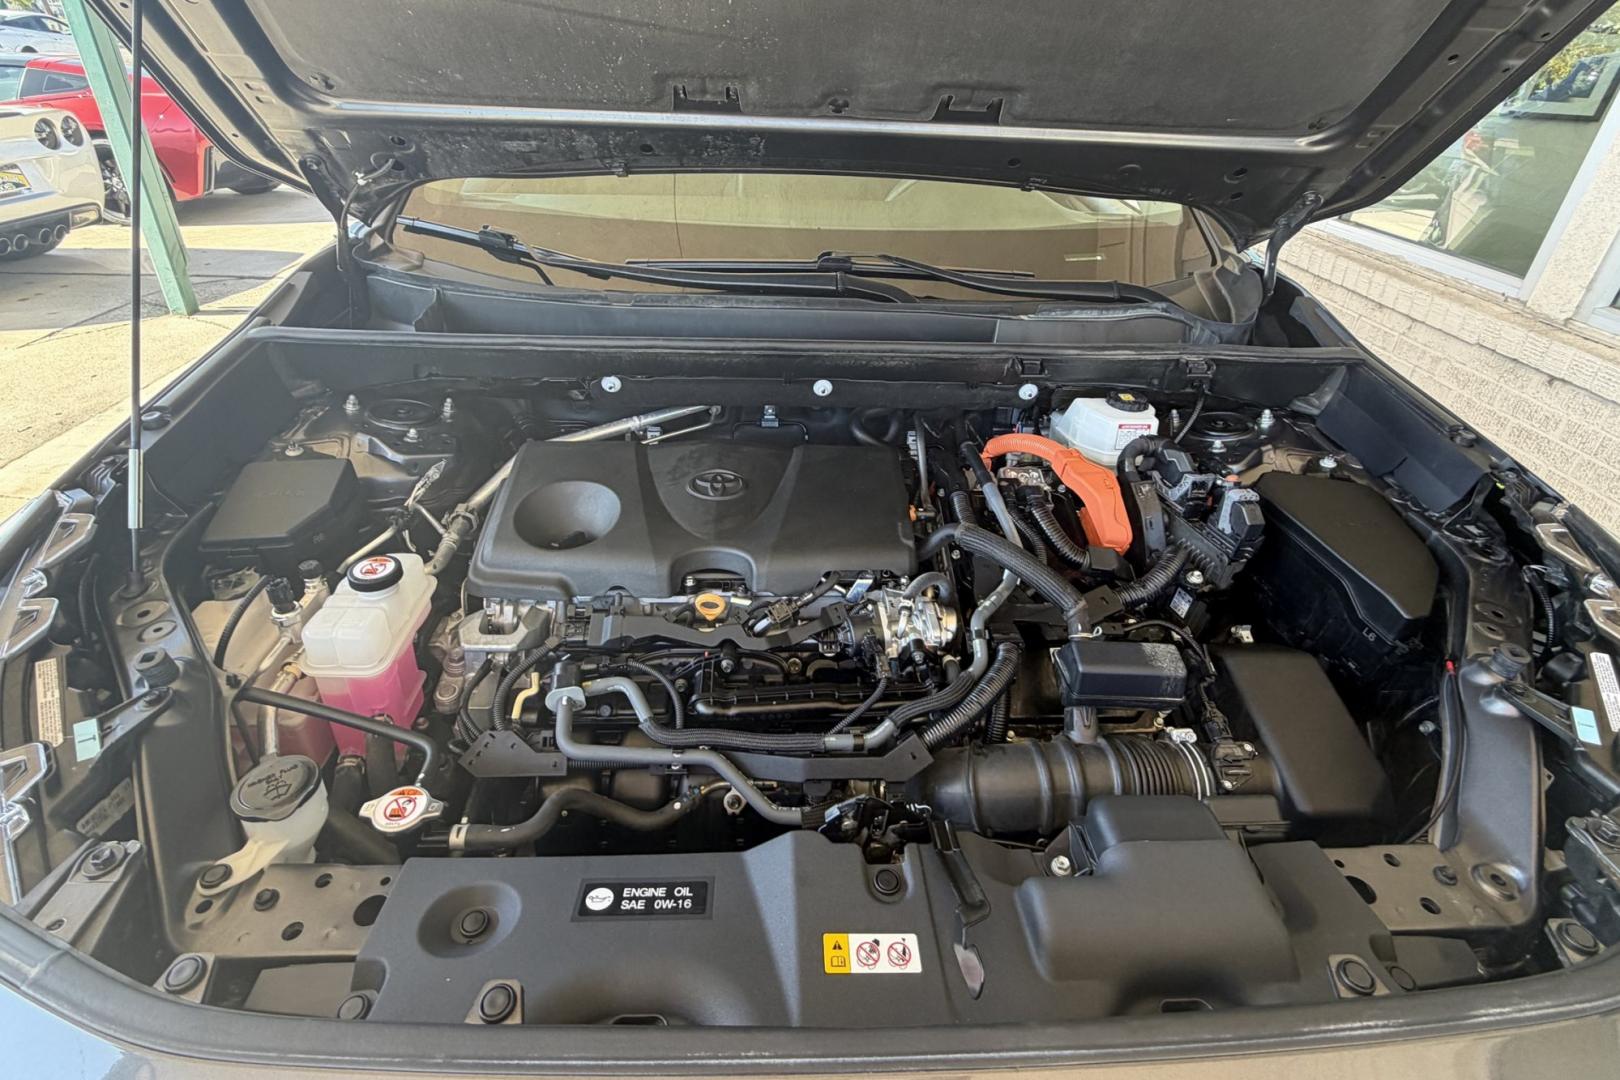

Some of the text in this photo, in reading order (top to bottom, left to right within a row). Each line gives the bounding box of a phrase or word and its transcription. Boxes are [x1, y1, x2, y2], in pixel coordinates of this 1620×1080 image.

[622, 887, 694, 897] ENGINE OIL
[620, 899, 692, 910] SAE 0W-16
